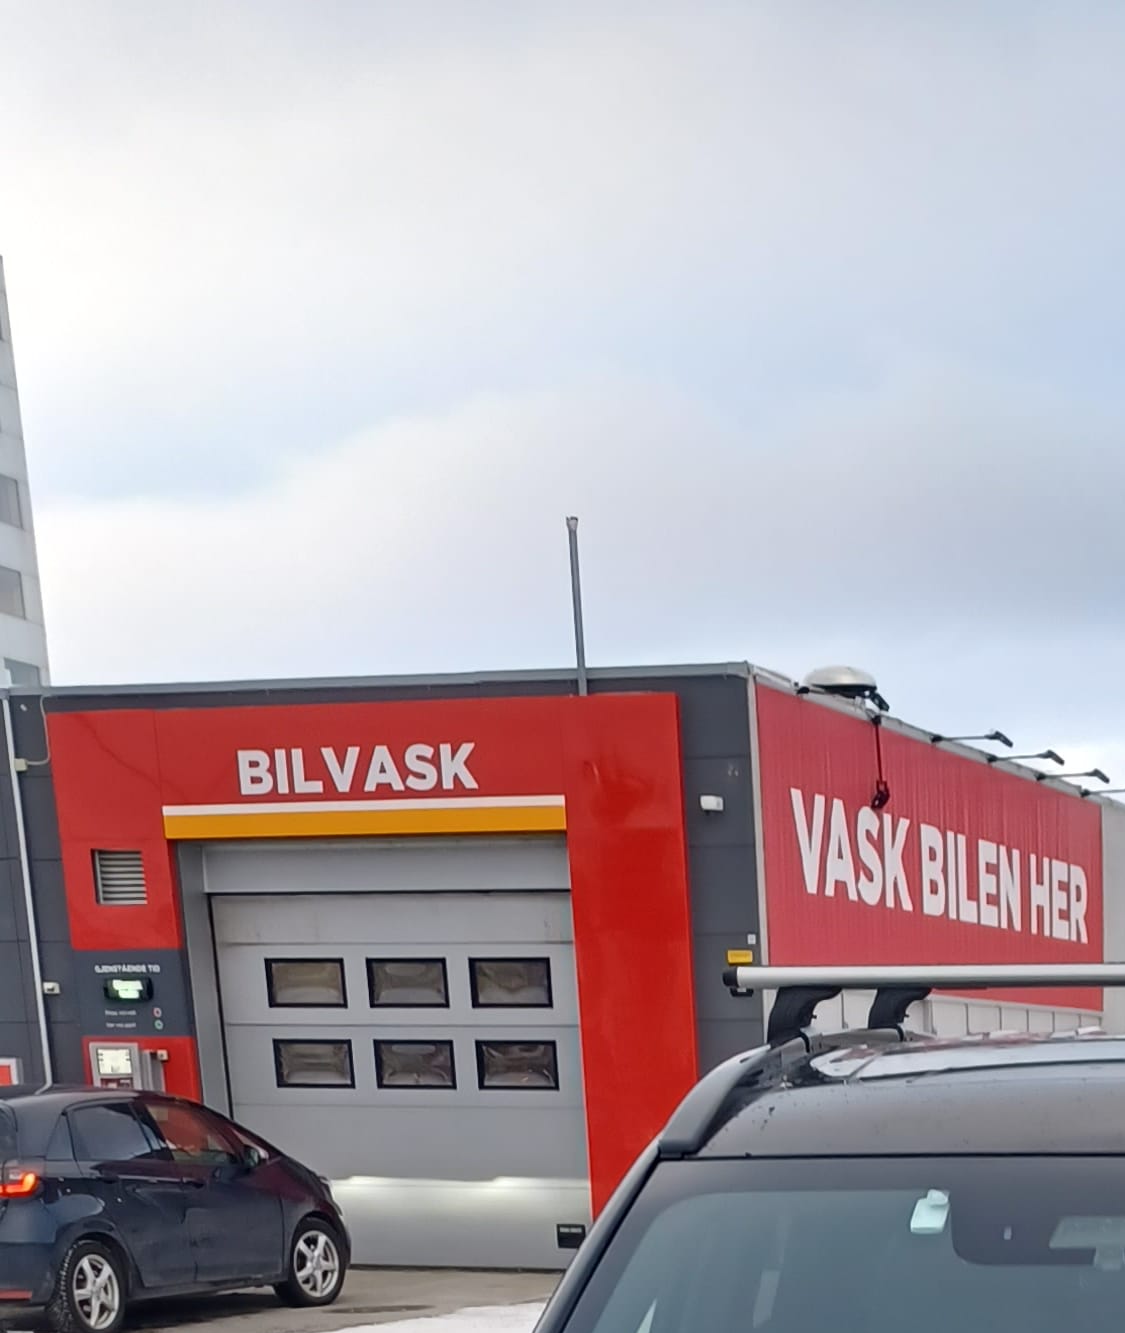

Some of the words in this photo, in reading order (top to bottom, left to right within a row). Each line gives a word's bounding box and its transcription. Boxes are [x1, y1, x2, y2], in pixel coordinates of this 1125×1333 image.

[237, 742, 479, 795] BILVASK
[790, 787, 914, 912] VASK
[920, 823, 1022, 932] BILEN
[1030, 853, 1089, 944] HER
